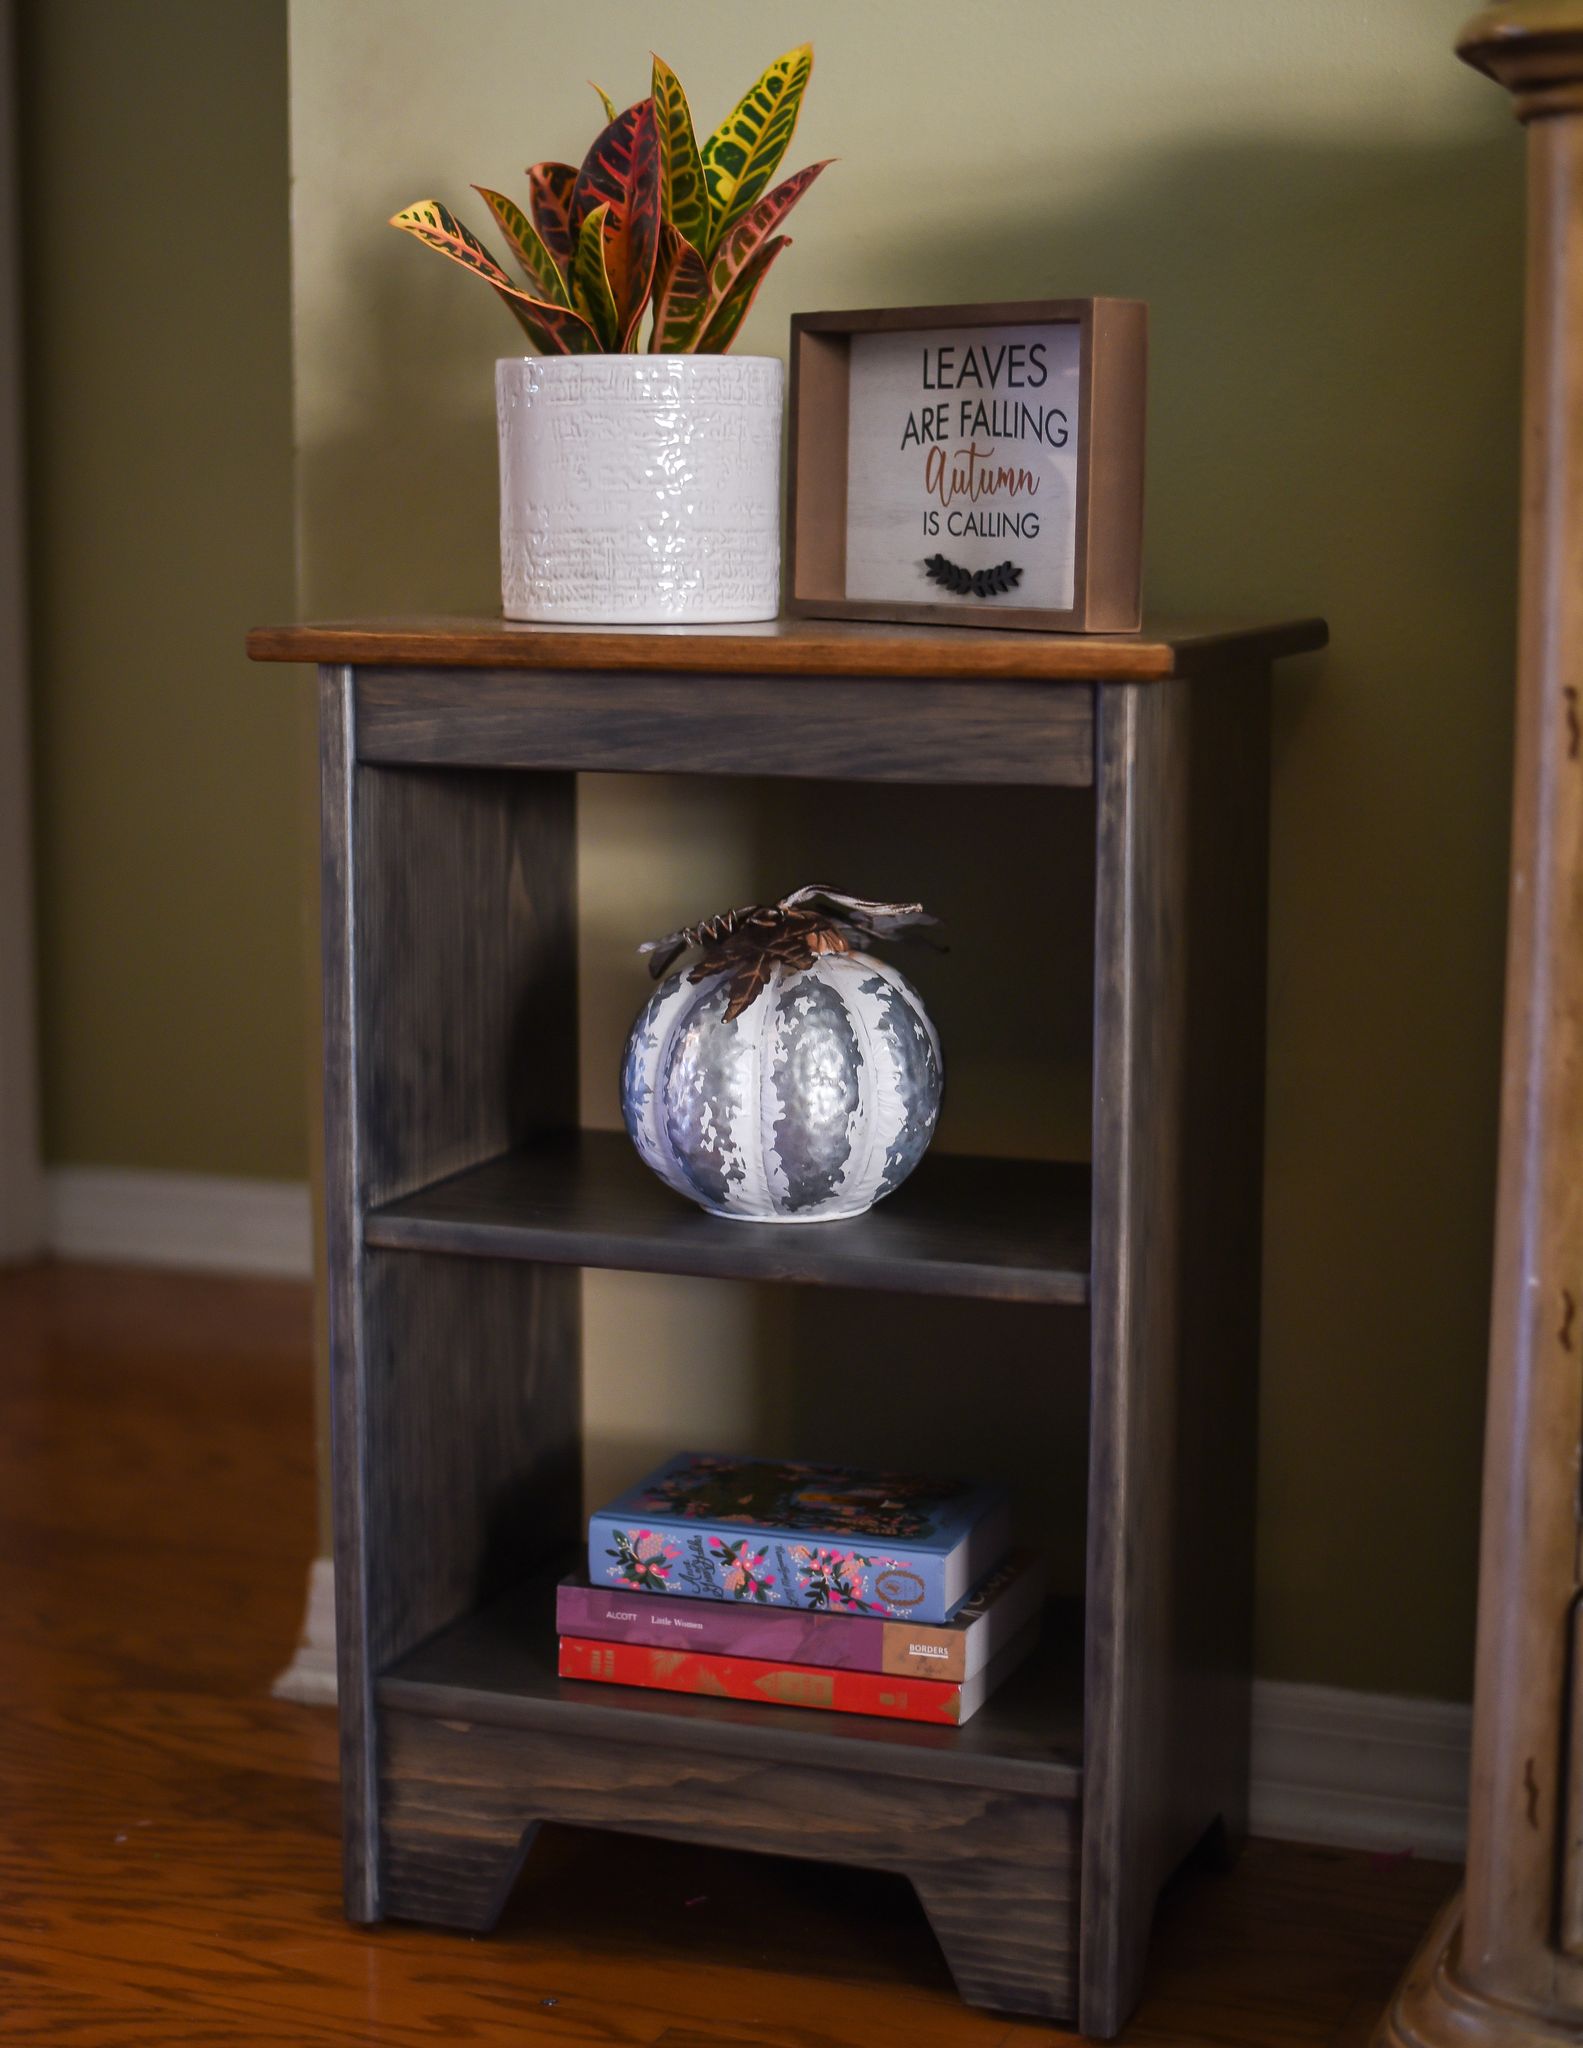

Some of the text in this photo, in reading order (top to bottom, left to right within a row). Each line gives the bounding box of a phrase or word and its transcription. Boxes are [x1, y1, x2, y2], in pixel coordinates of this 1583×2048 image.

[922, 343, 1048, 390] LEAVES
[901, 398, 1069, 451] ARE FALLING
[925, 441, 1041, 507] Autumn
[923, 511, 1041, 539] IS CALLING
[606, 1611, 638, 1621] ALCOTT
[651, 1615, 704, 1630] Little Women
[909, 1643, 949, 1656] BORDERS
